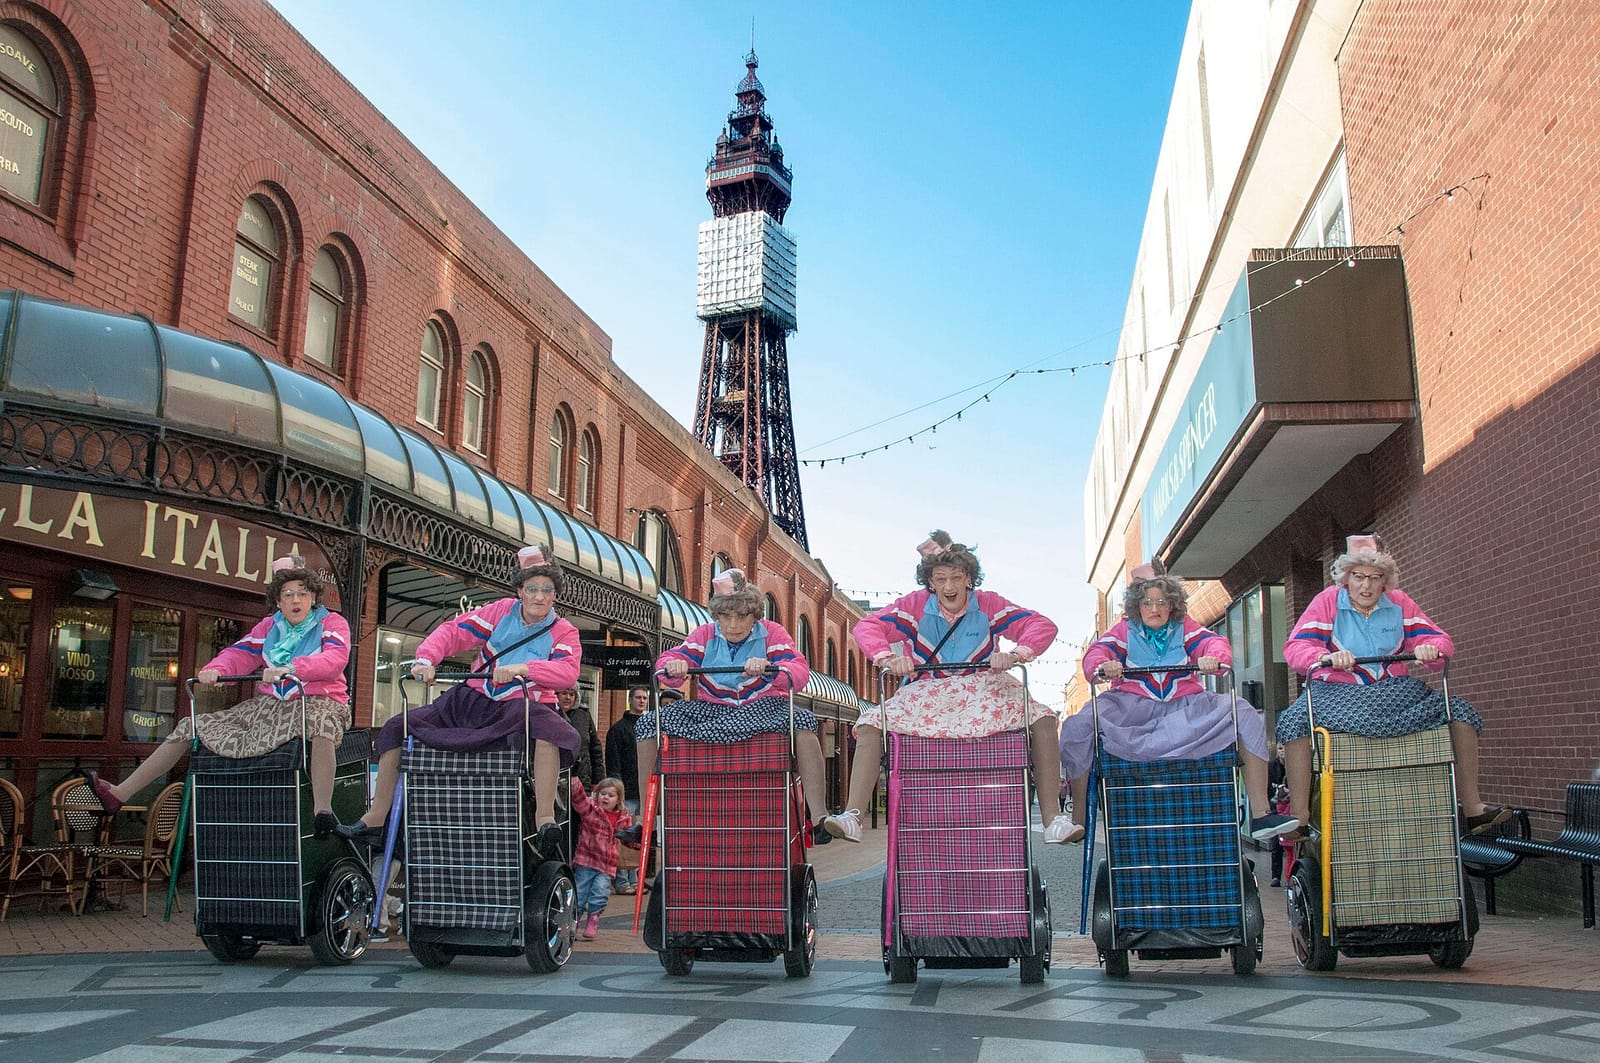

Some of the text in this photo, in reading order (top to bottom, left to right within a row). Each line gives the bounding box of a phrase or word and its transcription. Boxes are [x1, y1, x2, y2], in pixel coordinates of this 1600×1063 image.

[0, 43, 36, 73] SOAVE
[0, 108, 33, 136] SCIUTTO
[240, 255, 258, 273] STEAK
[0, 484, 301, 585] LA ITALI
[67, 651, 91, 668] VINO
[60, 667, 95, 681] ROSSO
[618, 668, 640, 676] Moon
[132, 713, 166, 728] GRIGLIA
